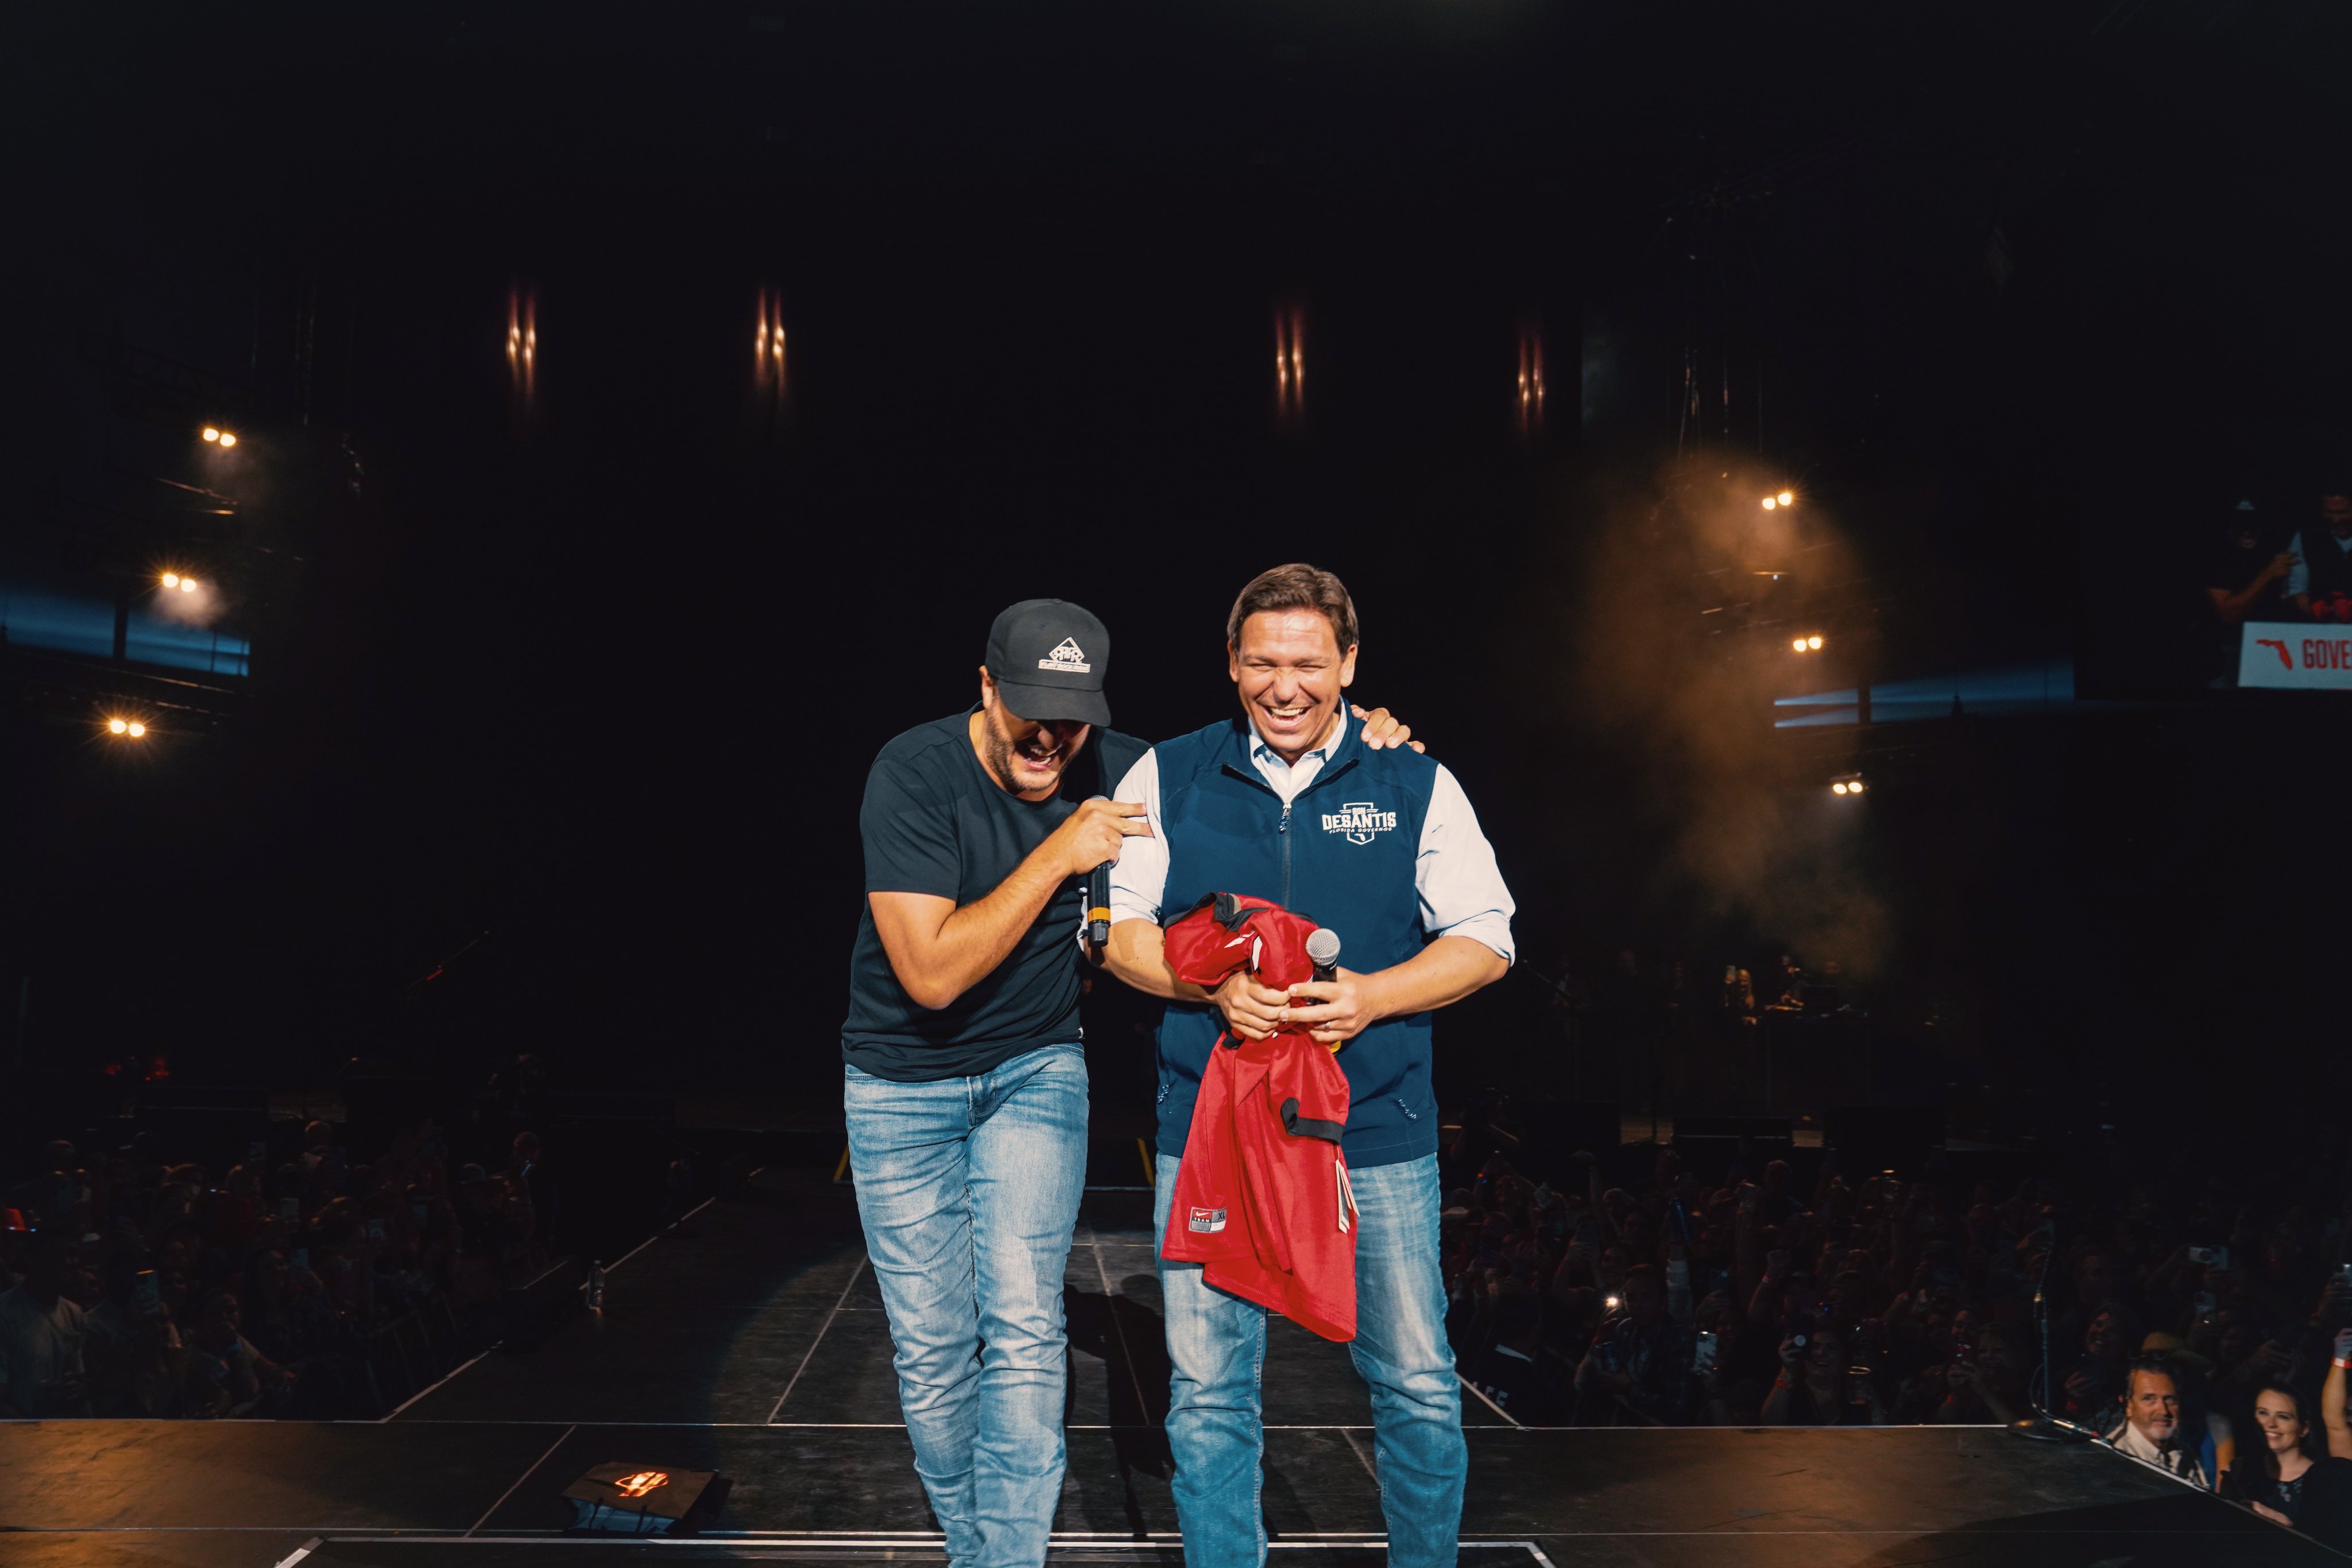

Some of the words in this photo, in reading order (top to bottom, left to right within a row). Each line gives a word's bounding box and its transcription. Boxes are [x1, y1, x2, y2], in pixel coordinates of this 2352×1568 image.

[2303, 639, 2352, 669] GOVE
[1321, 812, 1396, 830] DESANTIS
[1218, 1211, 1225, 1221] XL
